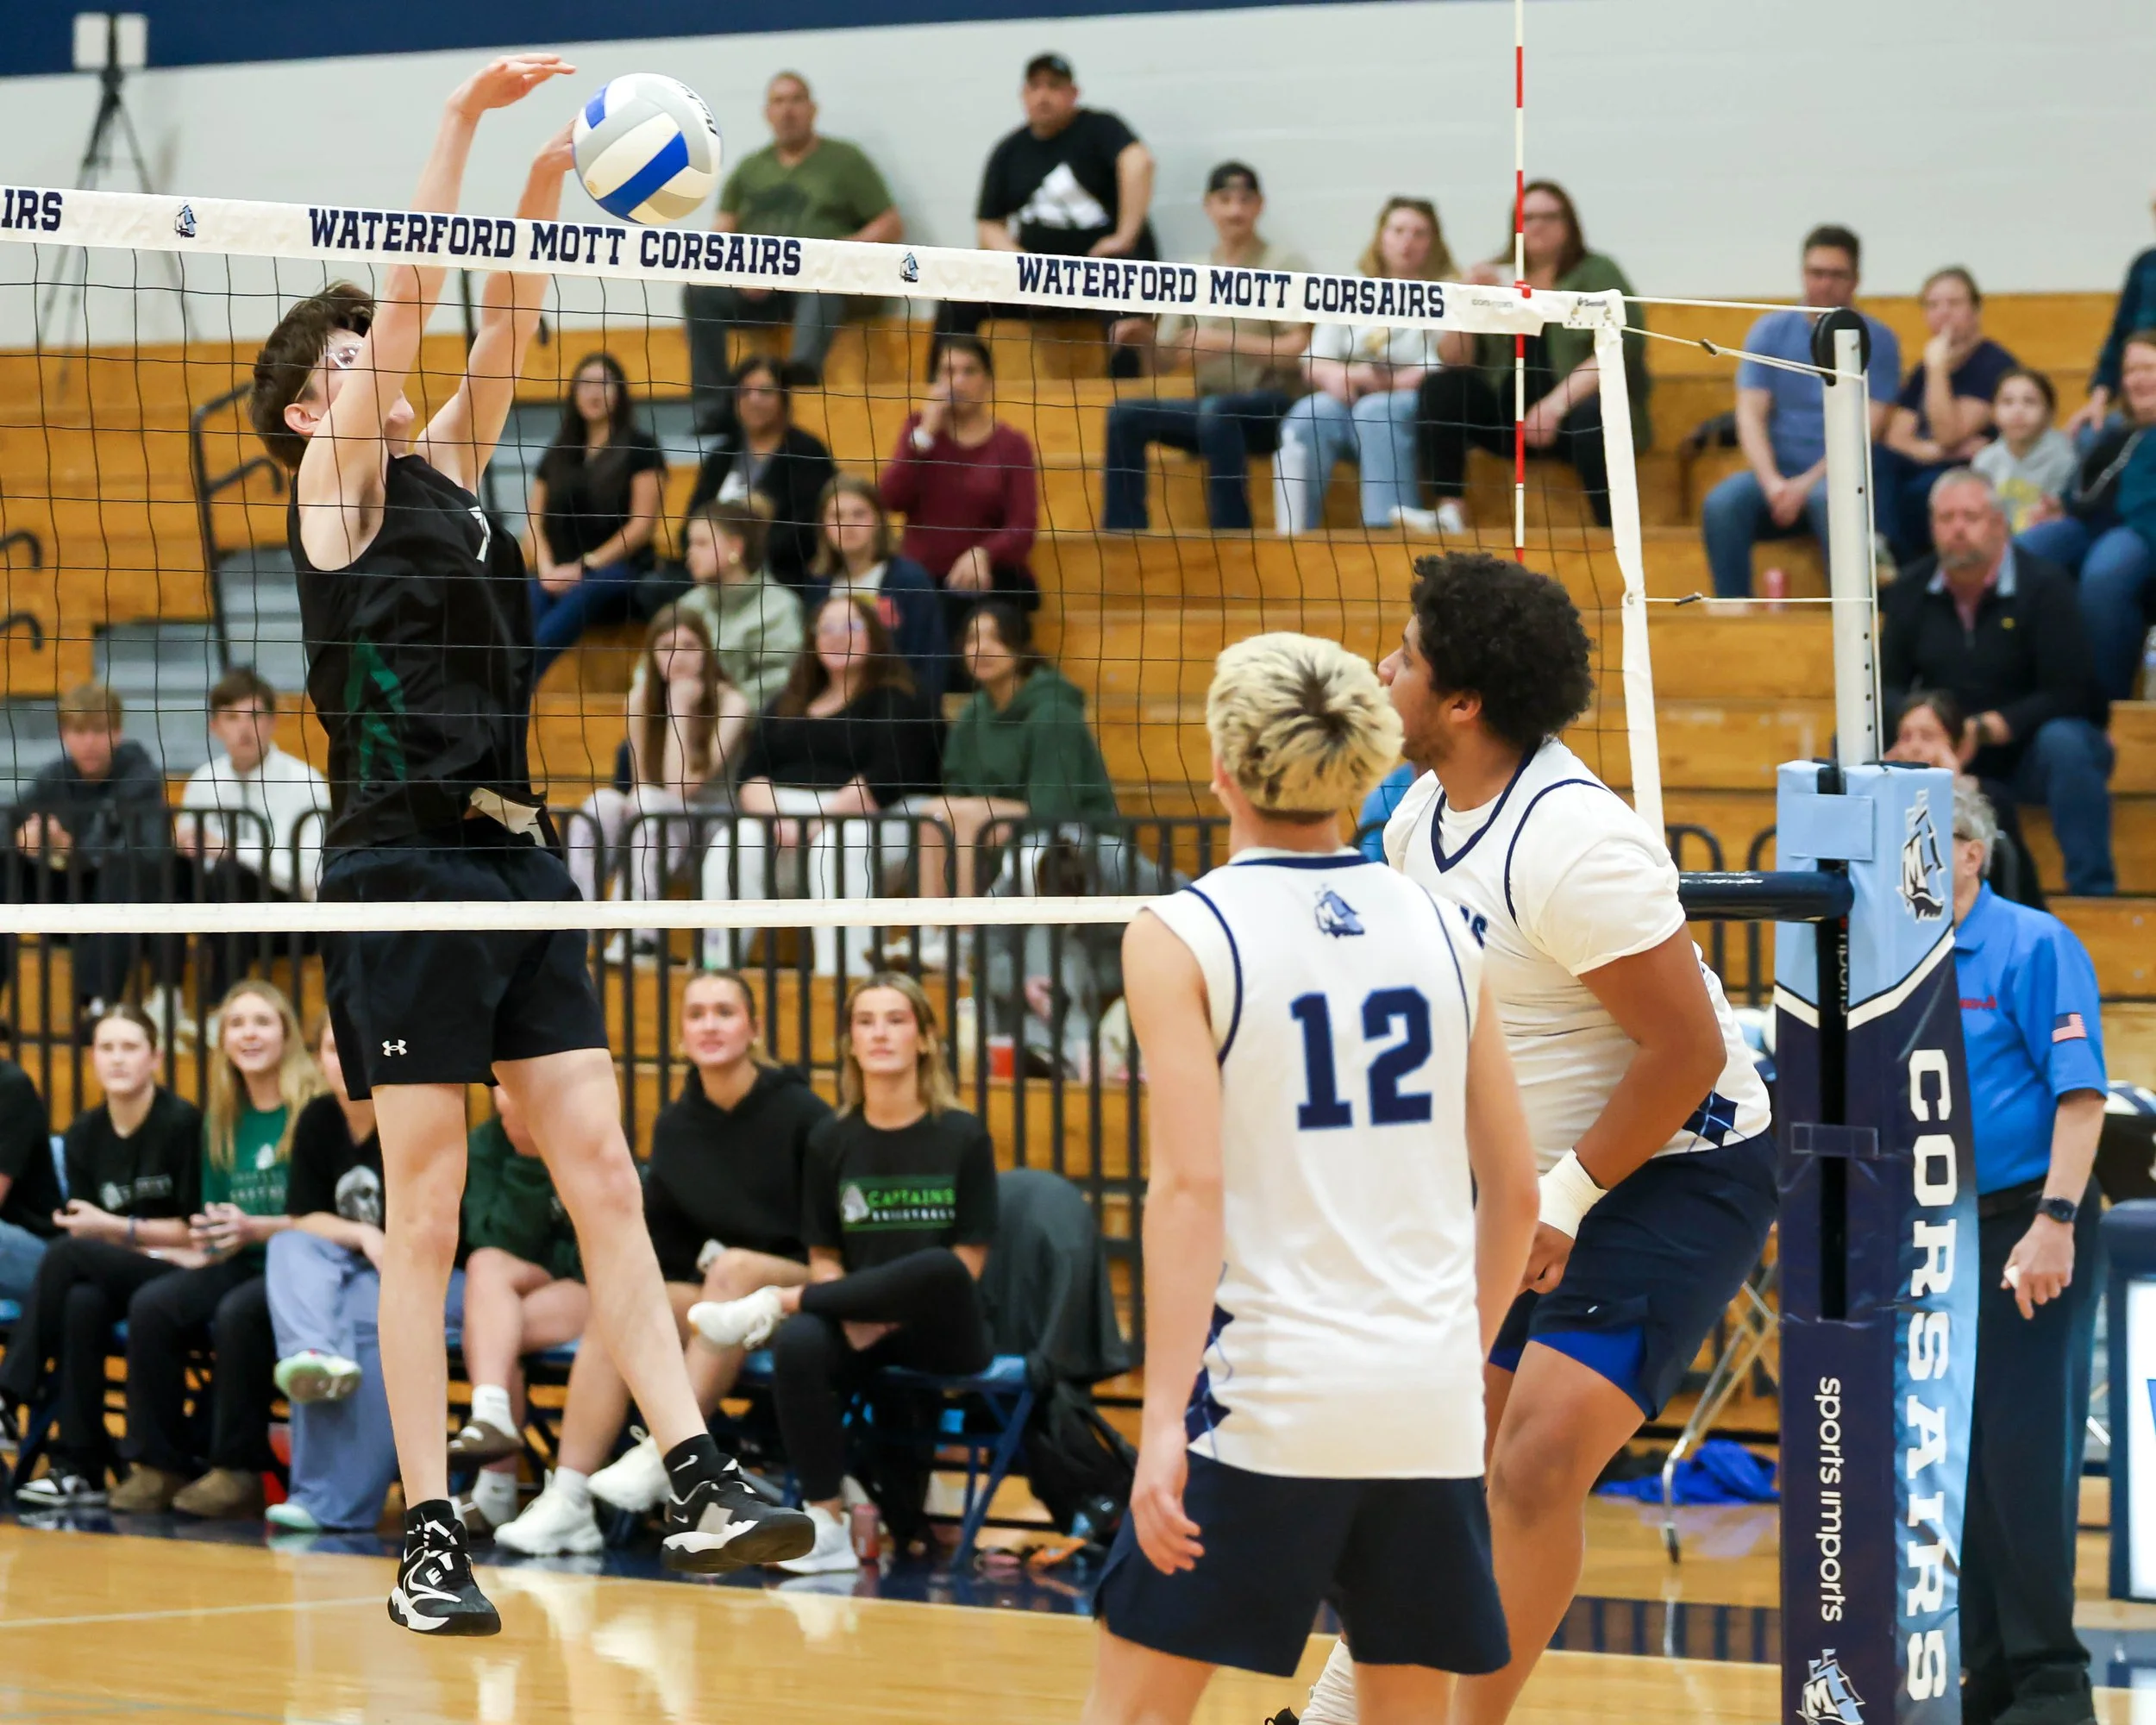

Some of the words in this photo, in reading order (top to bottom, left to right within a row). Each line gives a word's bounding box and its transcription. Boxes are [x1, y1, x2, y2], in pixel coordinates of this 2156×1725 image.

[1, 189, 63, 232] IRS
[309, 208, 516, 258] WATERFORD
[530, 223, 626, 266] MOTT
[640, 229, 801, 277] CORSAIRS
[1017, 255, 1197, 303] WATERFORD
[1210, 269, 1291, 309] MOTT
[1304, 276, 1445, 319] CORSAIRS
[1290, 985, 1432, 1131] 12
[868, 1188, 956, 1208] CAPTAINS
[1906, 1049, 1958, 1701] CORSAIRS
[1814, 1377, 1845, 1485] sports
[1814, 1490, 1846, 1622] imports
